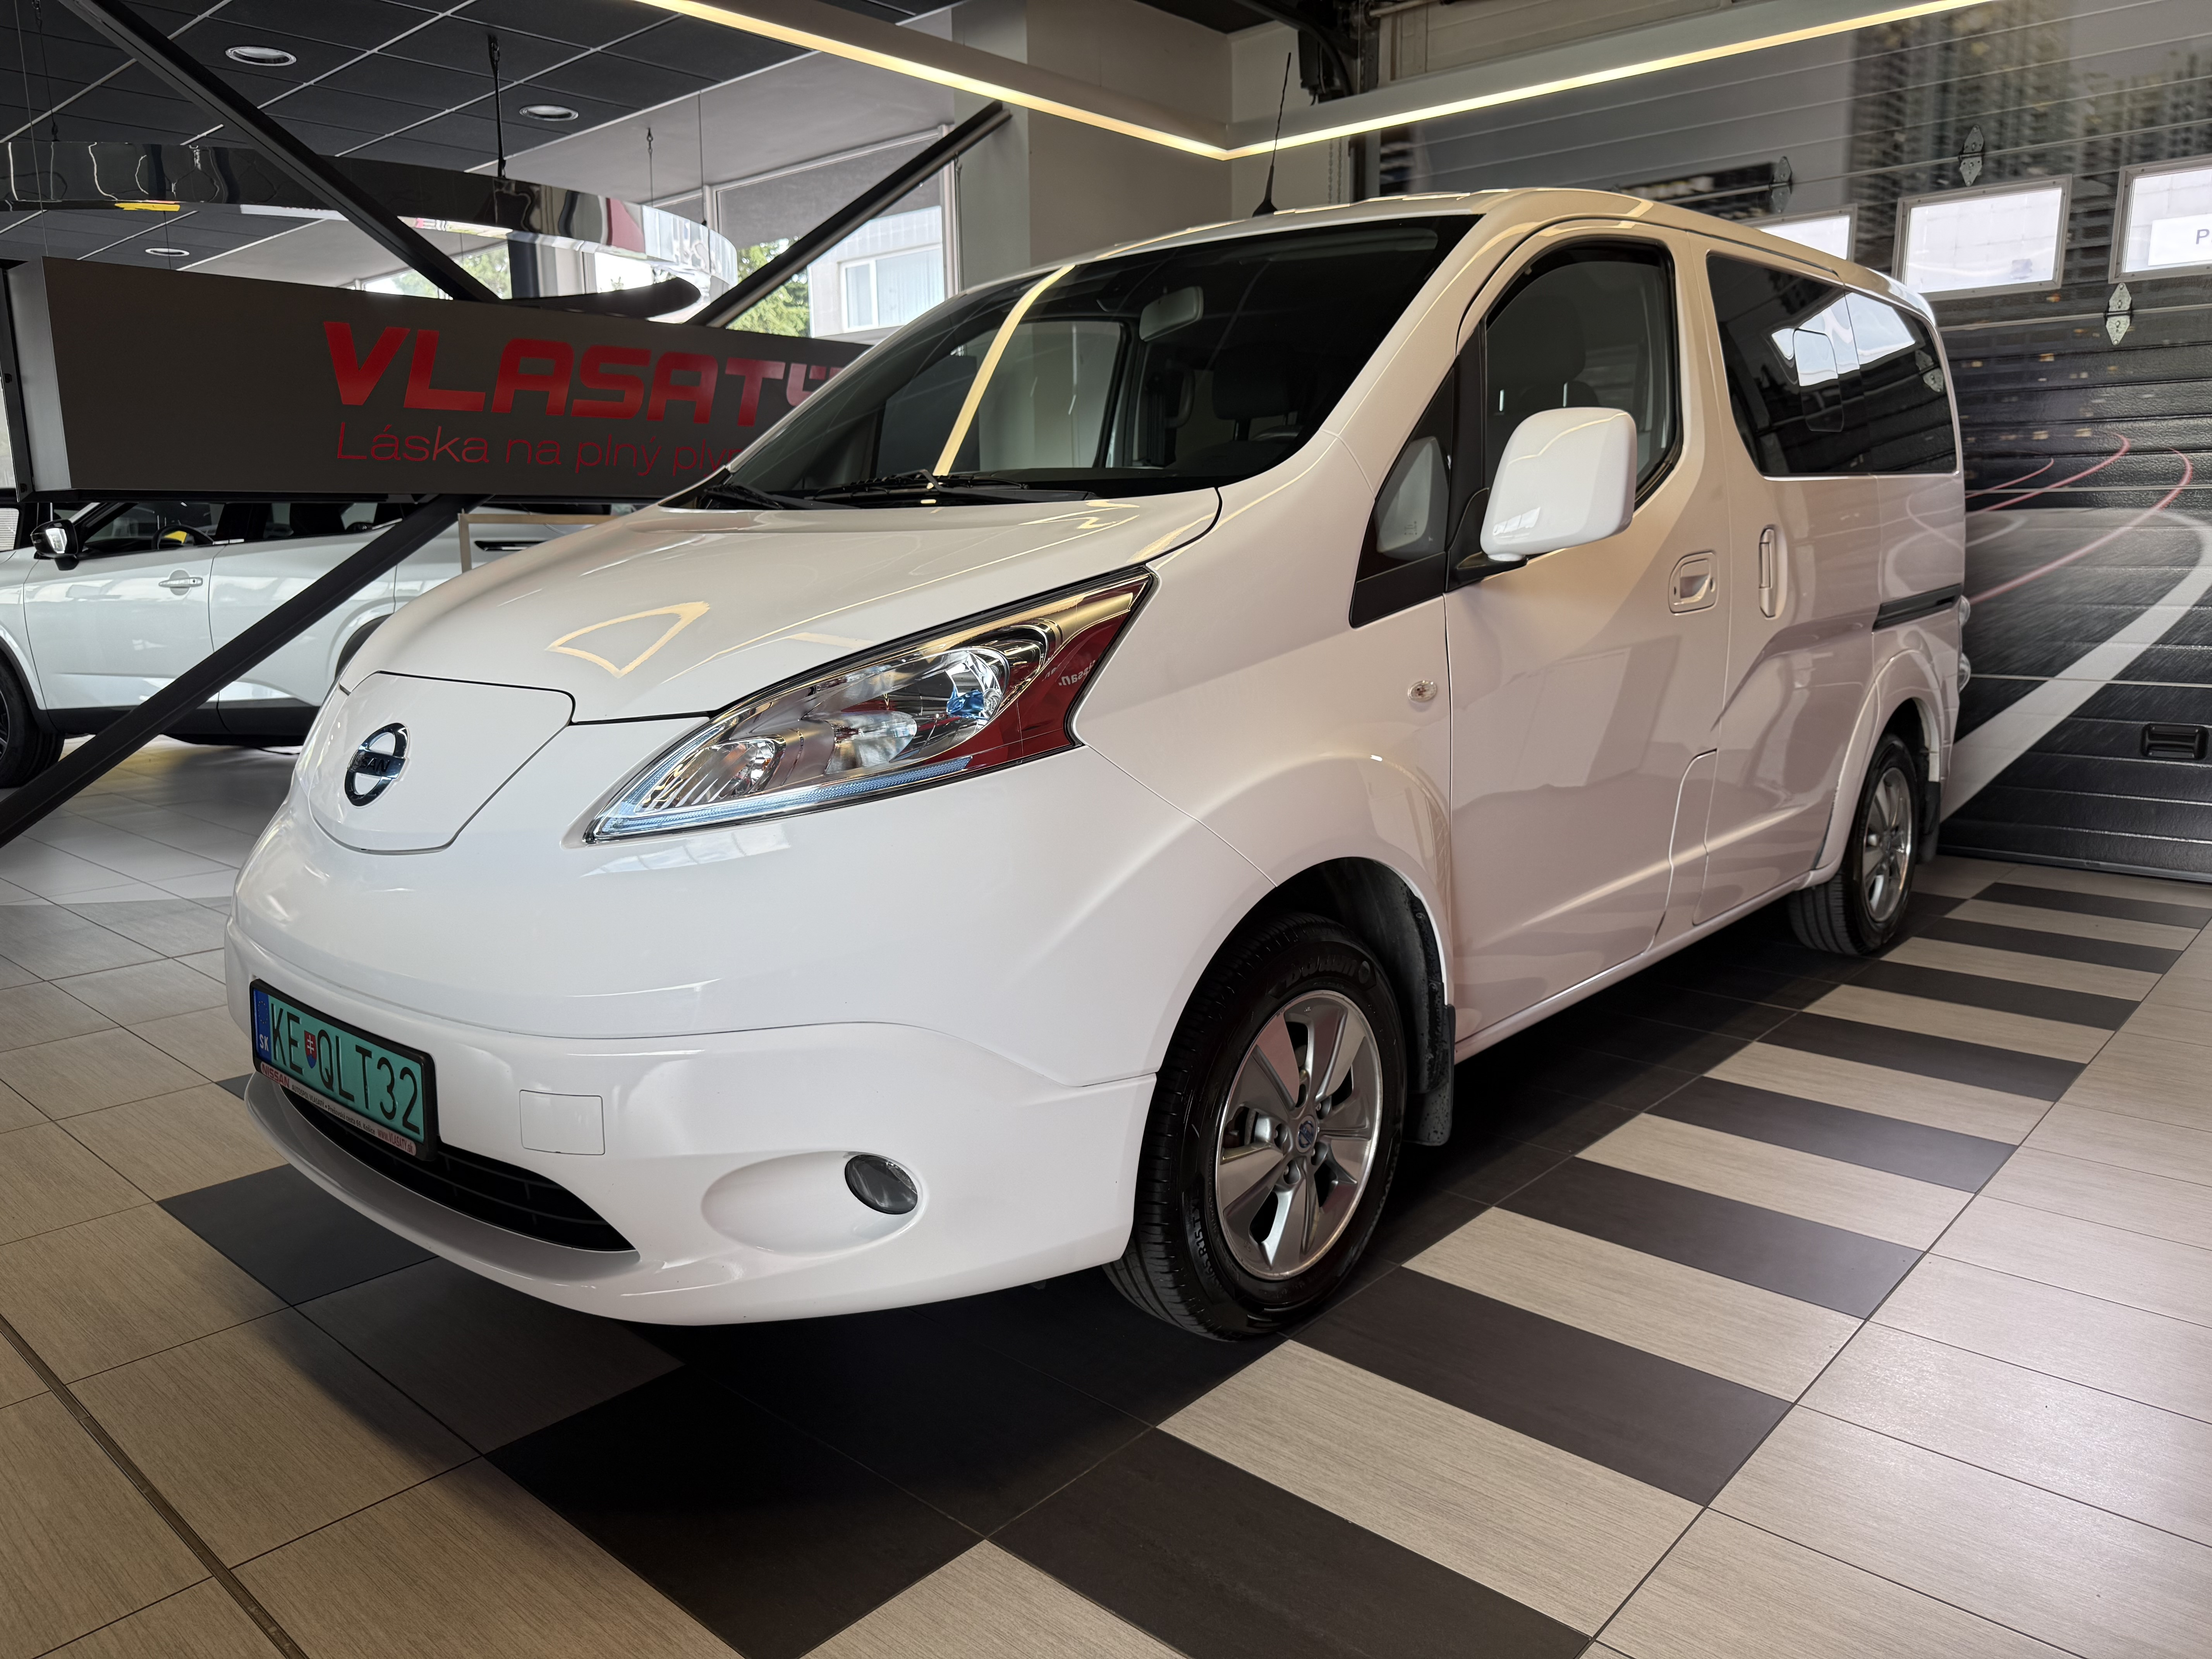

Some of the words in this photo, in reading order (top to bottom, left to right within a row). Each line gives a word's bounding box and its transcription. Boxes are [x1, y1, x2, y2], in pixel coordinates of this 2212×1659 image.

[2196, 229, 2212, 245] P
[337, 422, 489, 463] Láska
[505, 439, 561, 465] na
[575, 434, 661, 477] plný
[259, 1034, 269, 1052] SK
[271, 1003, 303, 1075] KE
[317, 1029, 420, 1135] QLT32
[262, 1064, 290, 1089] NISSAN
[292, 1085, 309, 1100] AUTOSPOL
[328, 1104, 345, 1120] Prešovská
[346, 1116, 356, 1125] cesta
[363, 1123, 375, 1135] Košice
[1194, 1228, 1208, 1258] R15
